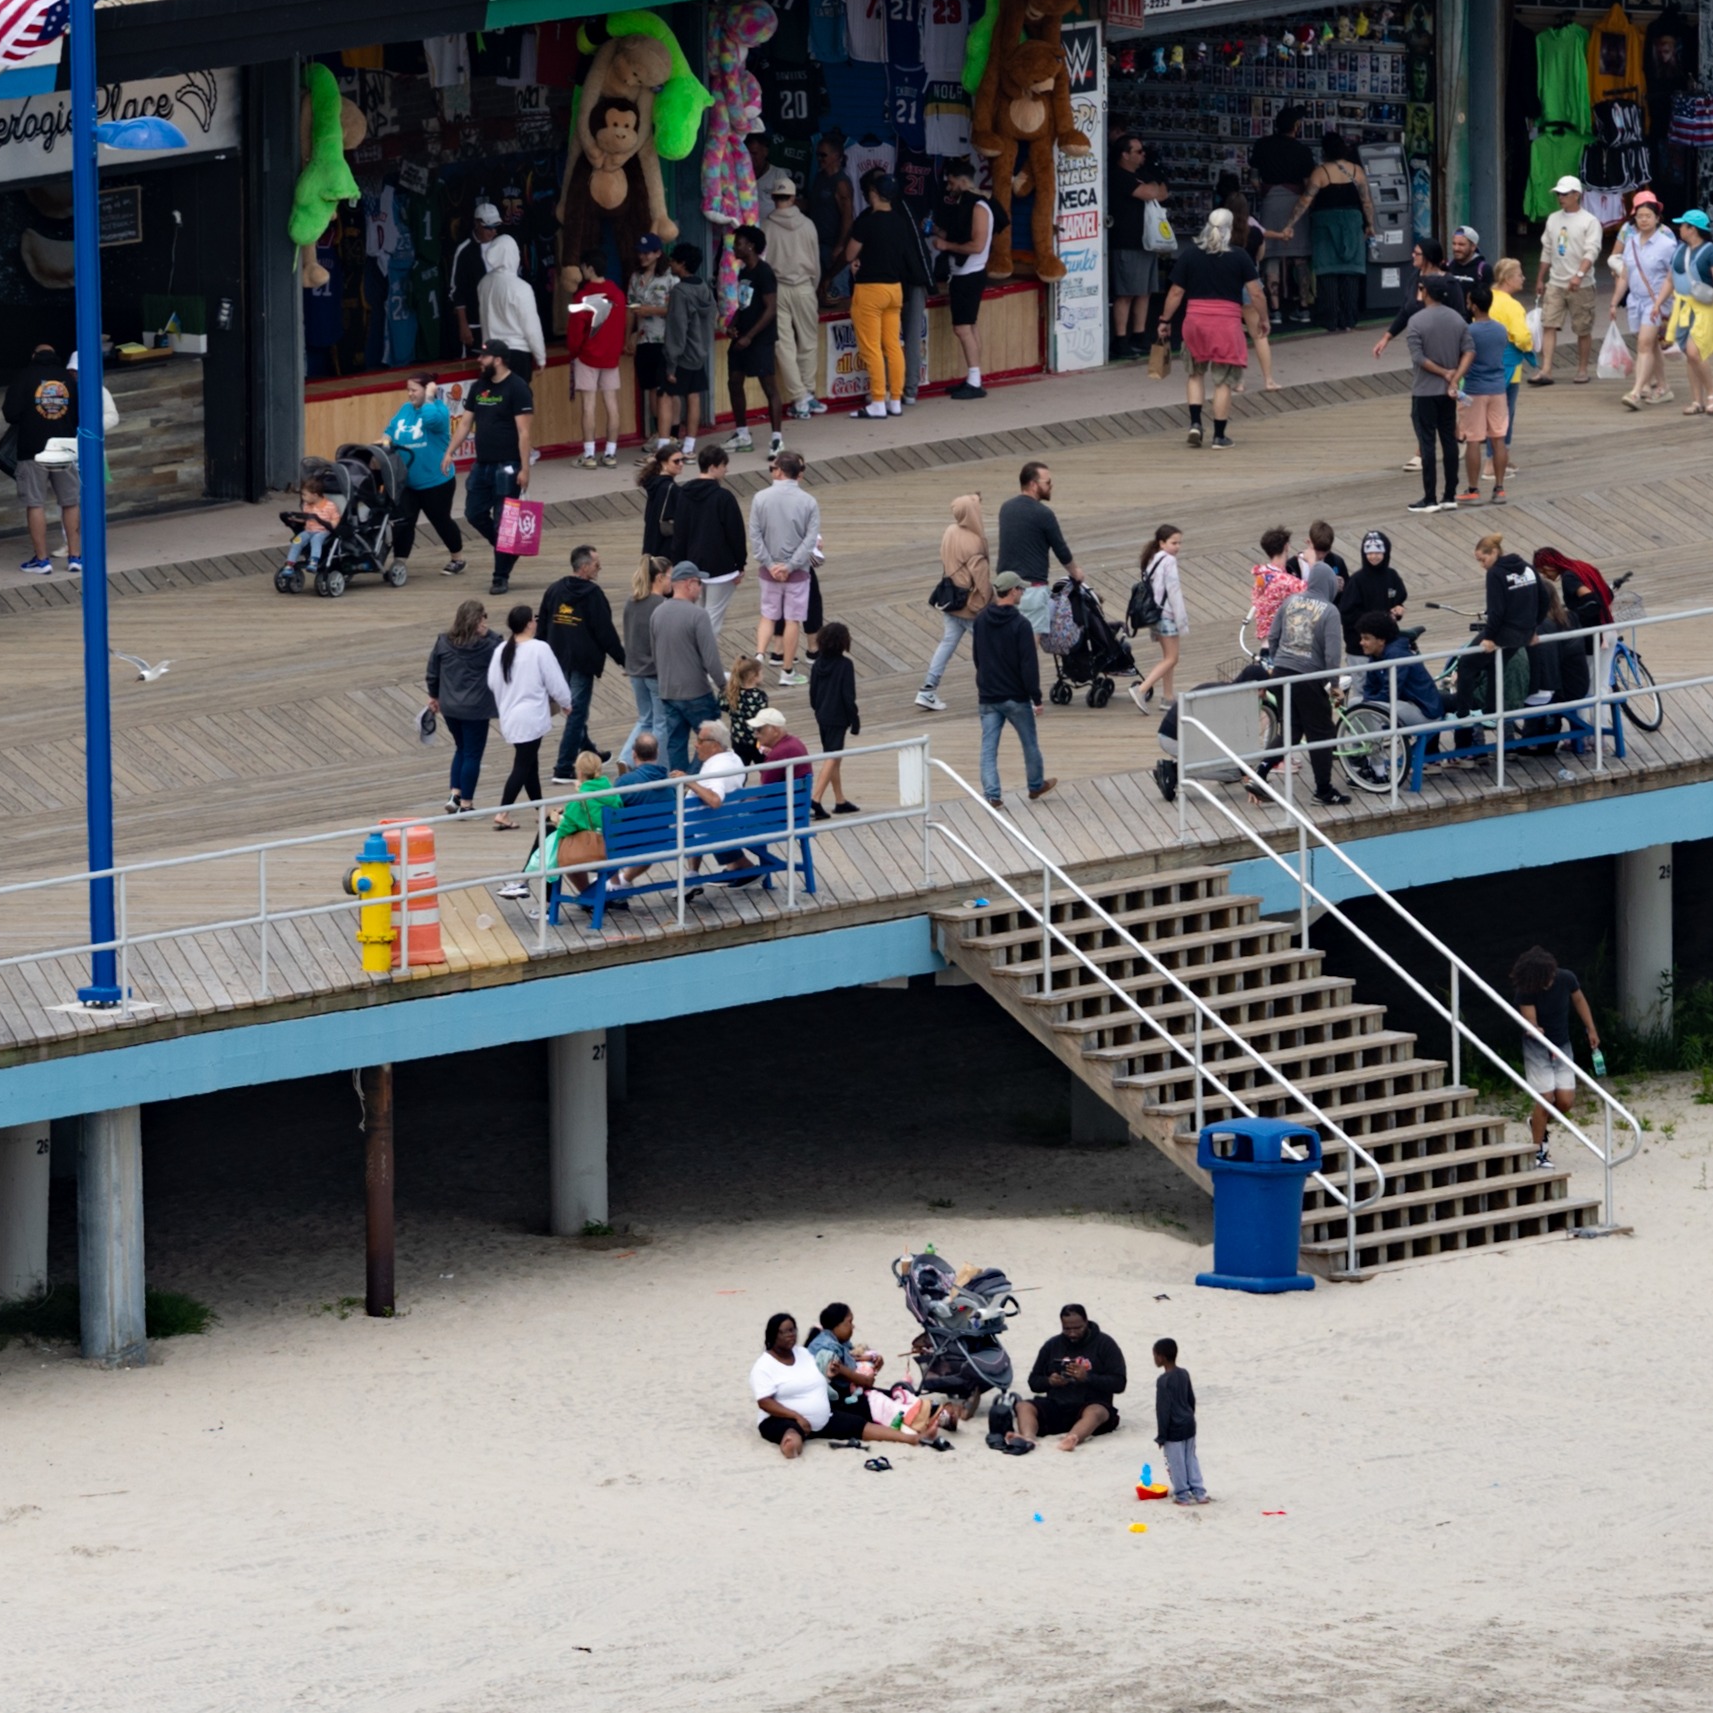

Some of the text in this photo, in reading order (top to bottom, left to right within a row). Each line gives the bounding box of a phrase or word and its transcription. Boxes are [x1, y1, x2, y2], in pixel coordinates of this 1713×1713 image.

[933, 0, 962, 24] 23
[779, 90, 808, 120] 20
[895, 99, 918, 125] 21
[903, 174, 925, 196] 21
[421, 210, 432, 240] 1
[1059, 213, 1097, 241] MARVEL
[428, 289, 440, 319] 1
[592, 1044, 607, 1060] 27
